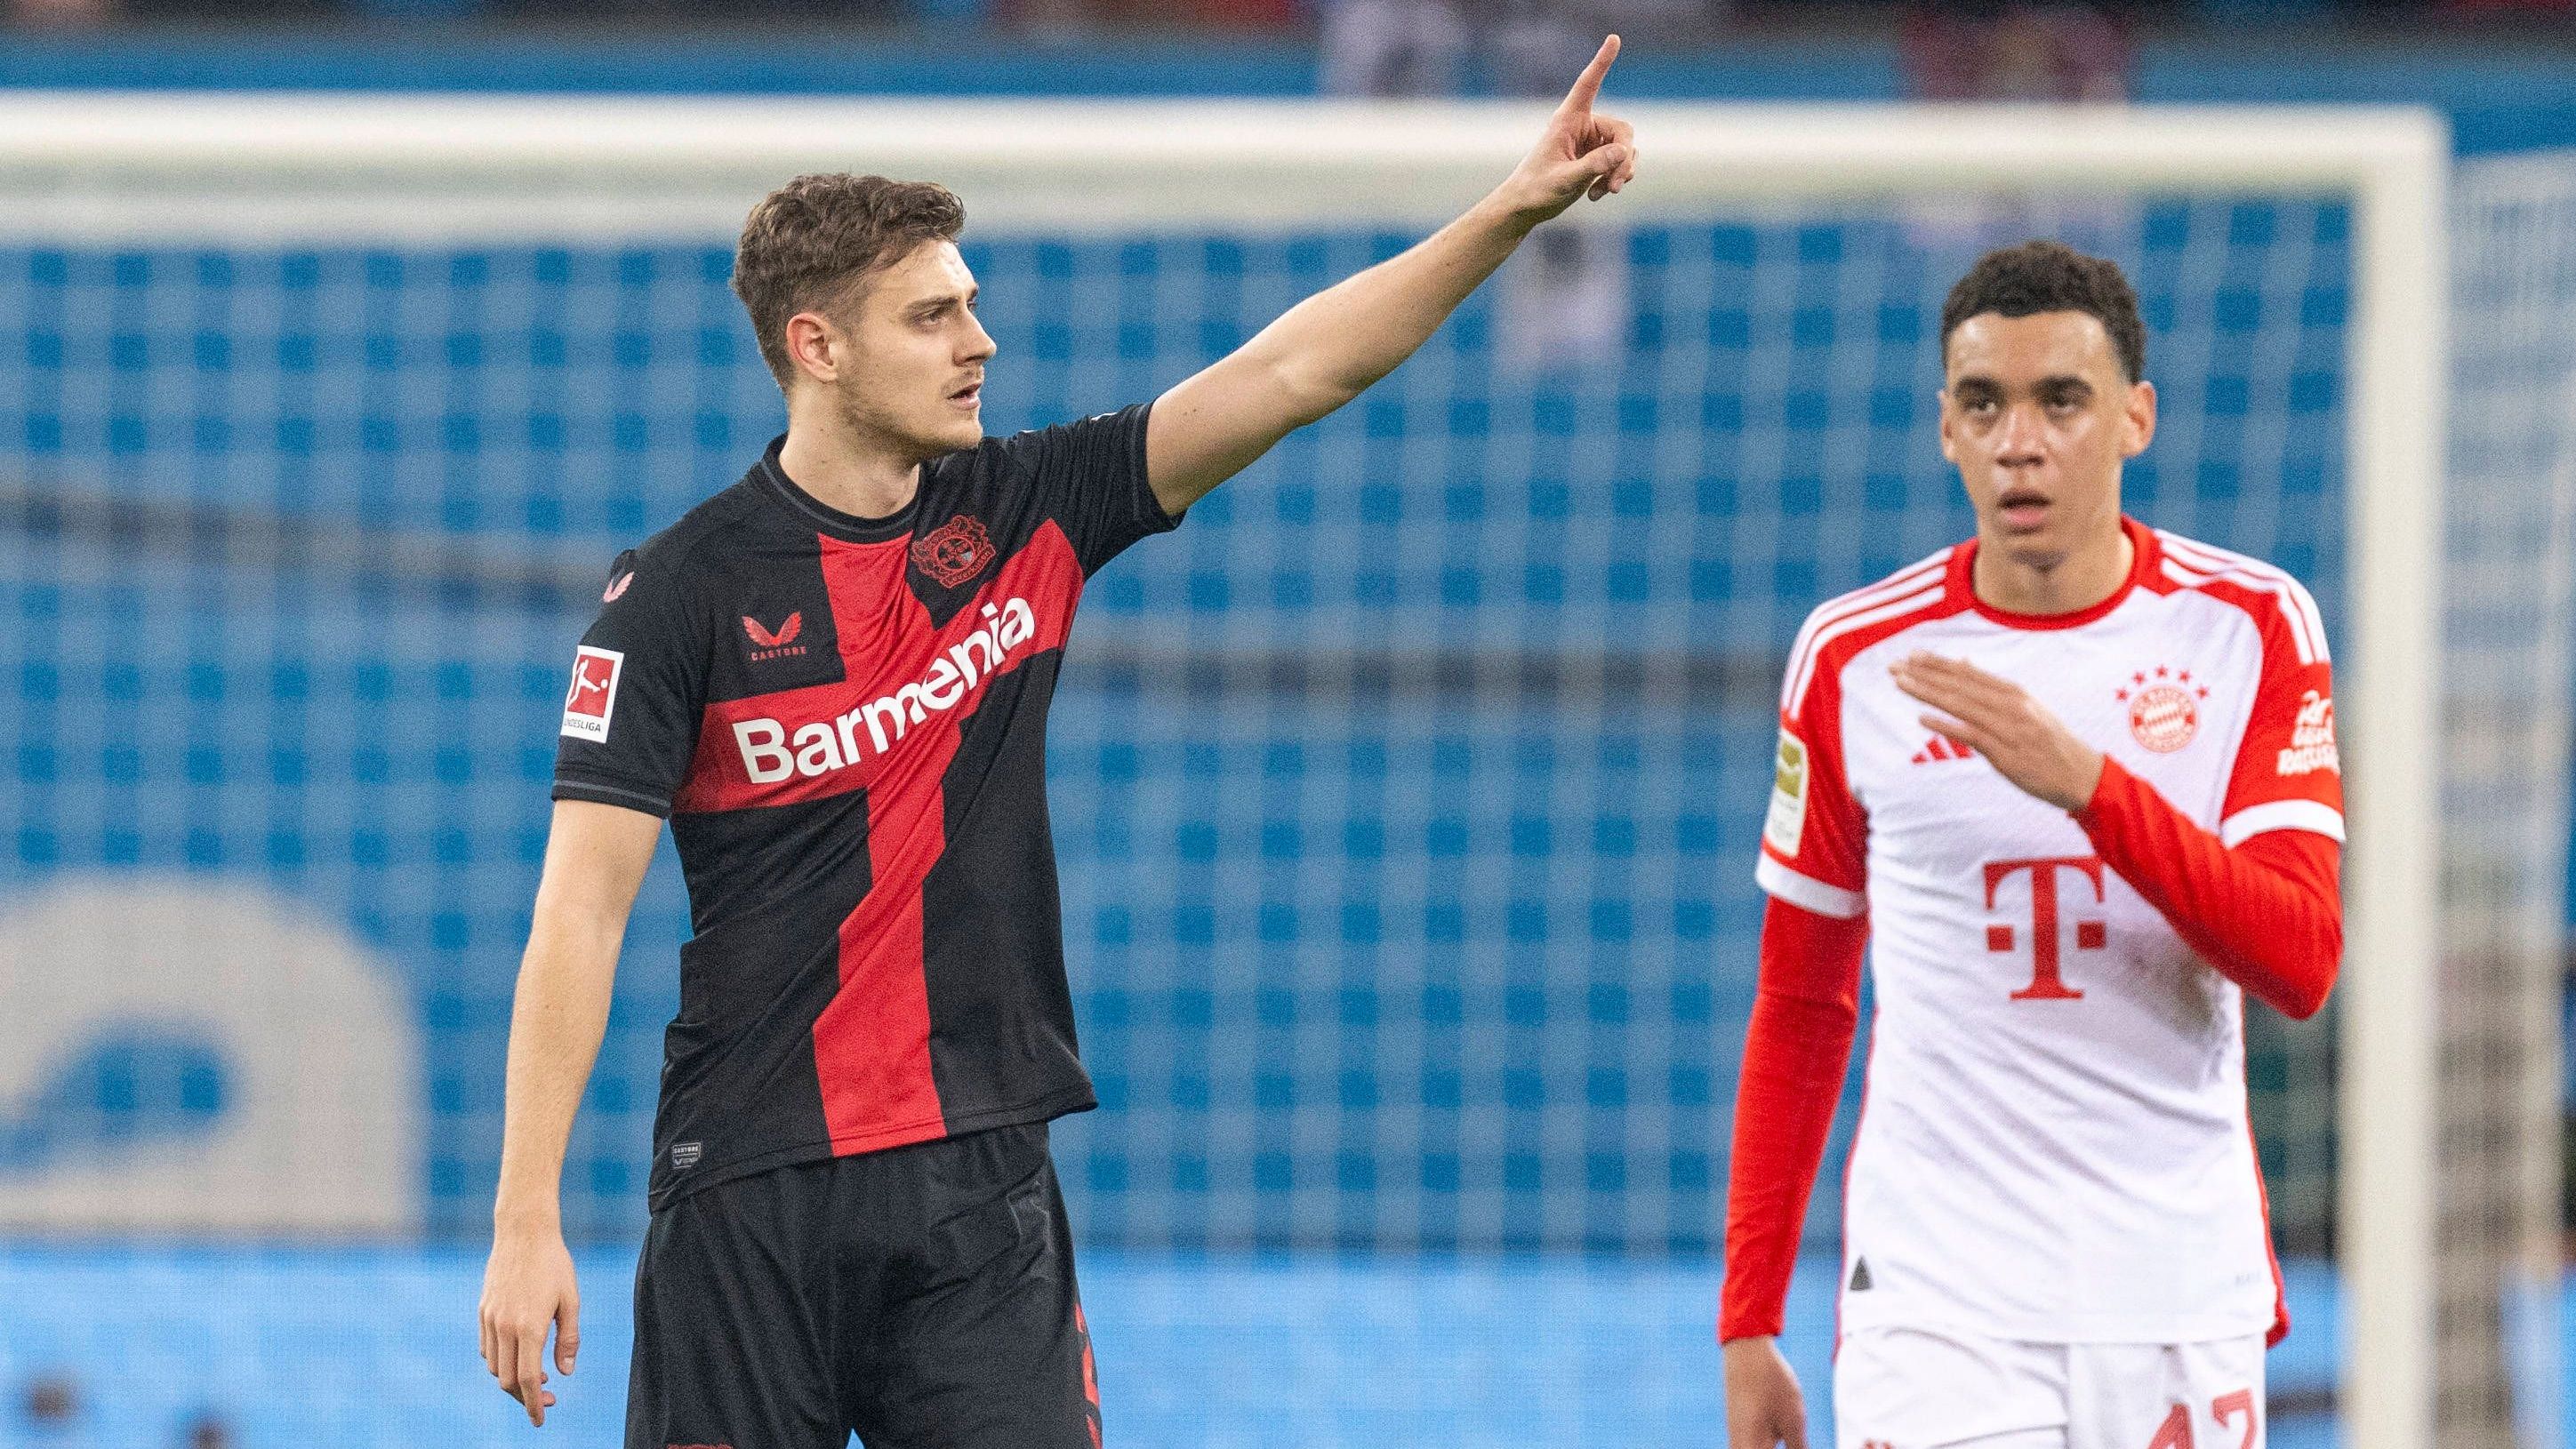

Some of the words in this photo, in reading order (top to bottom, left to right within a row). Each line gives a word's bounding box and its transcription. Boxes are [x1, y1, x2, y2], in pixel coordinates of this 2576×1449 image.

[732, 596, 1035, 784] Barmenia
[751, 645, 807, 661] CASTORE
[1983, 856, 2106, 1001] T
